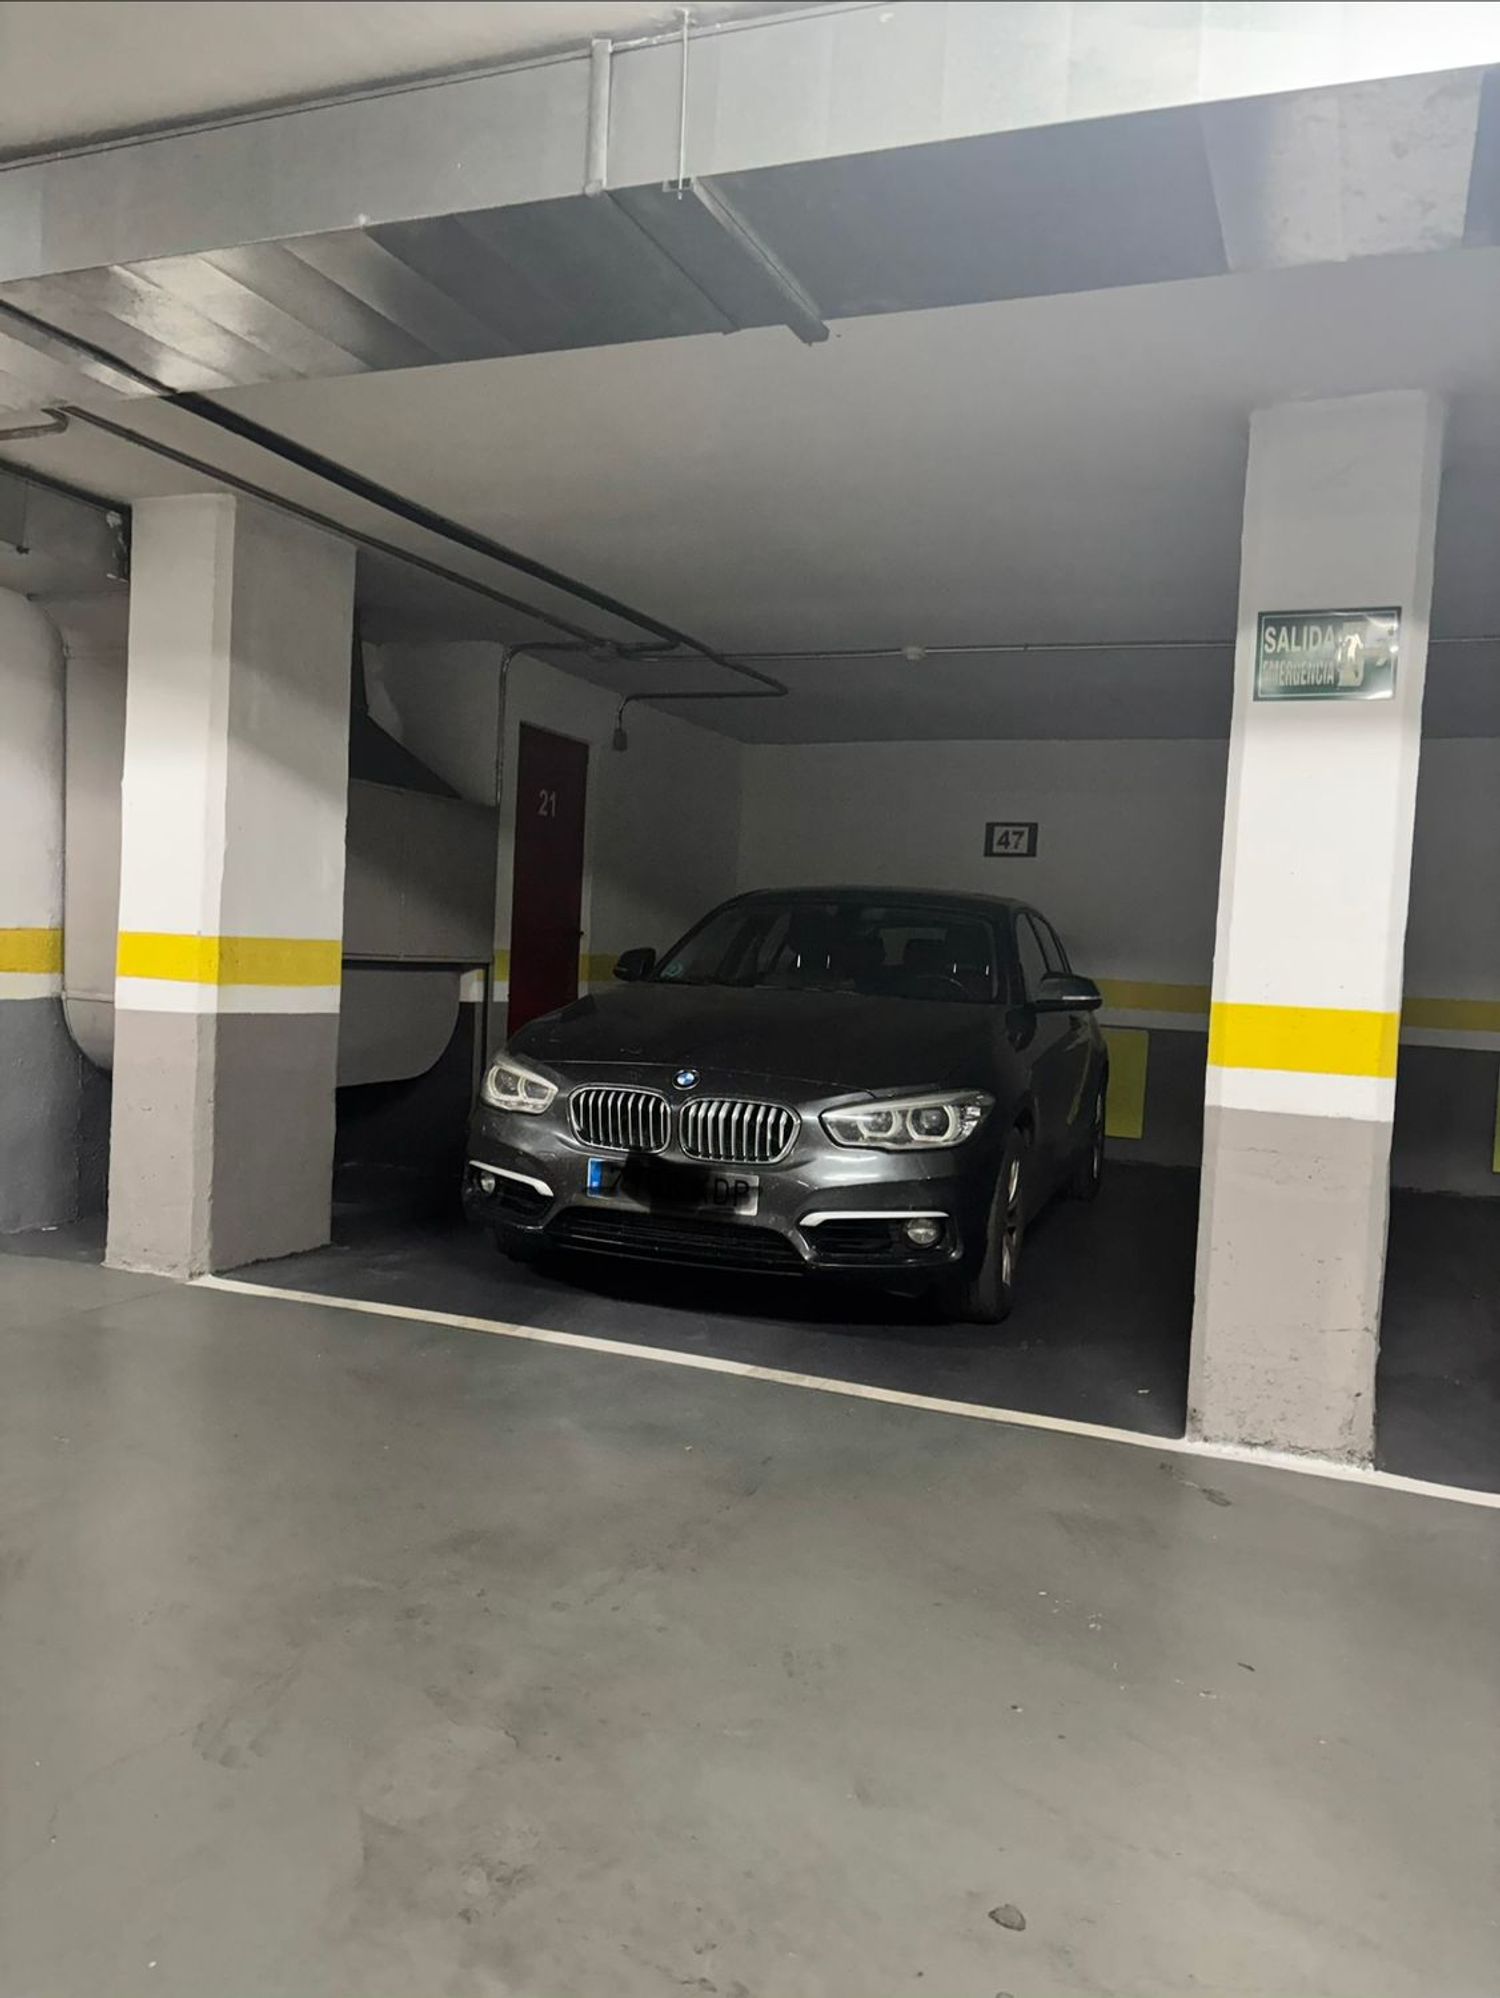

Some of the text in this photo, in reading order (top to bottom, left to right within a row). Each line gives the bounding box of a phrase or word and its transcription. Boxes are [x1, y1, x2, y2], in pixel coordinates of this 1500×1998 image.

[1264, 624, 1335, 653] SALIDA
[538, 789, 556, 817] 21
[996, 830, 1025, 850] 47
